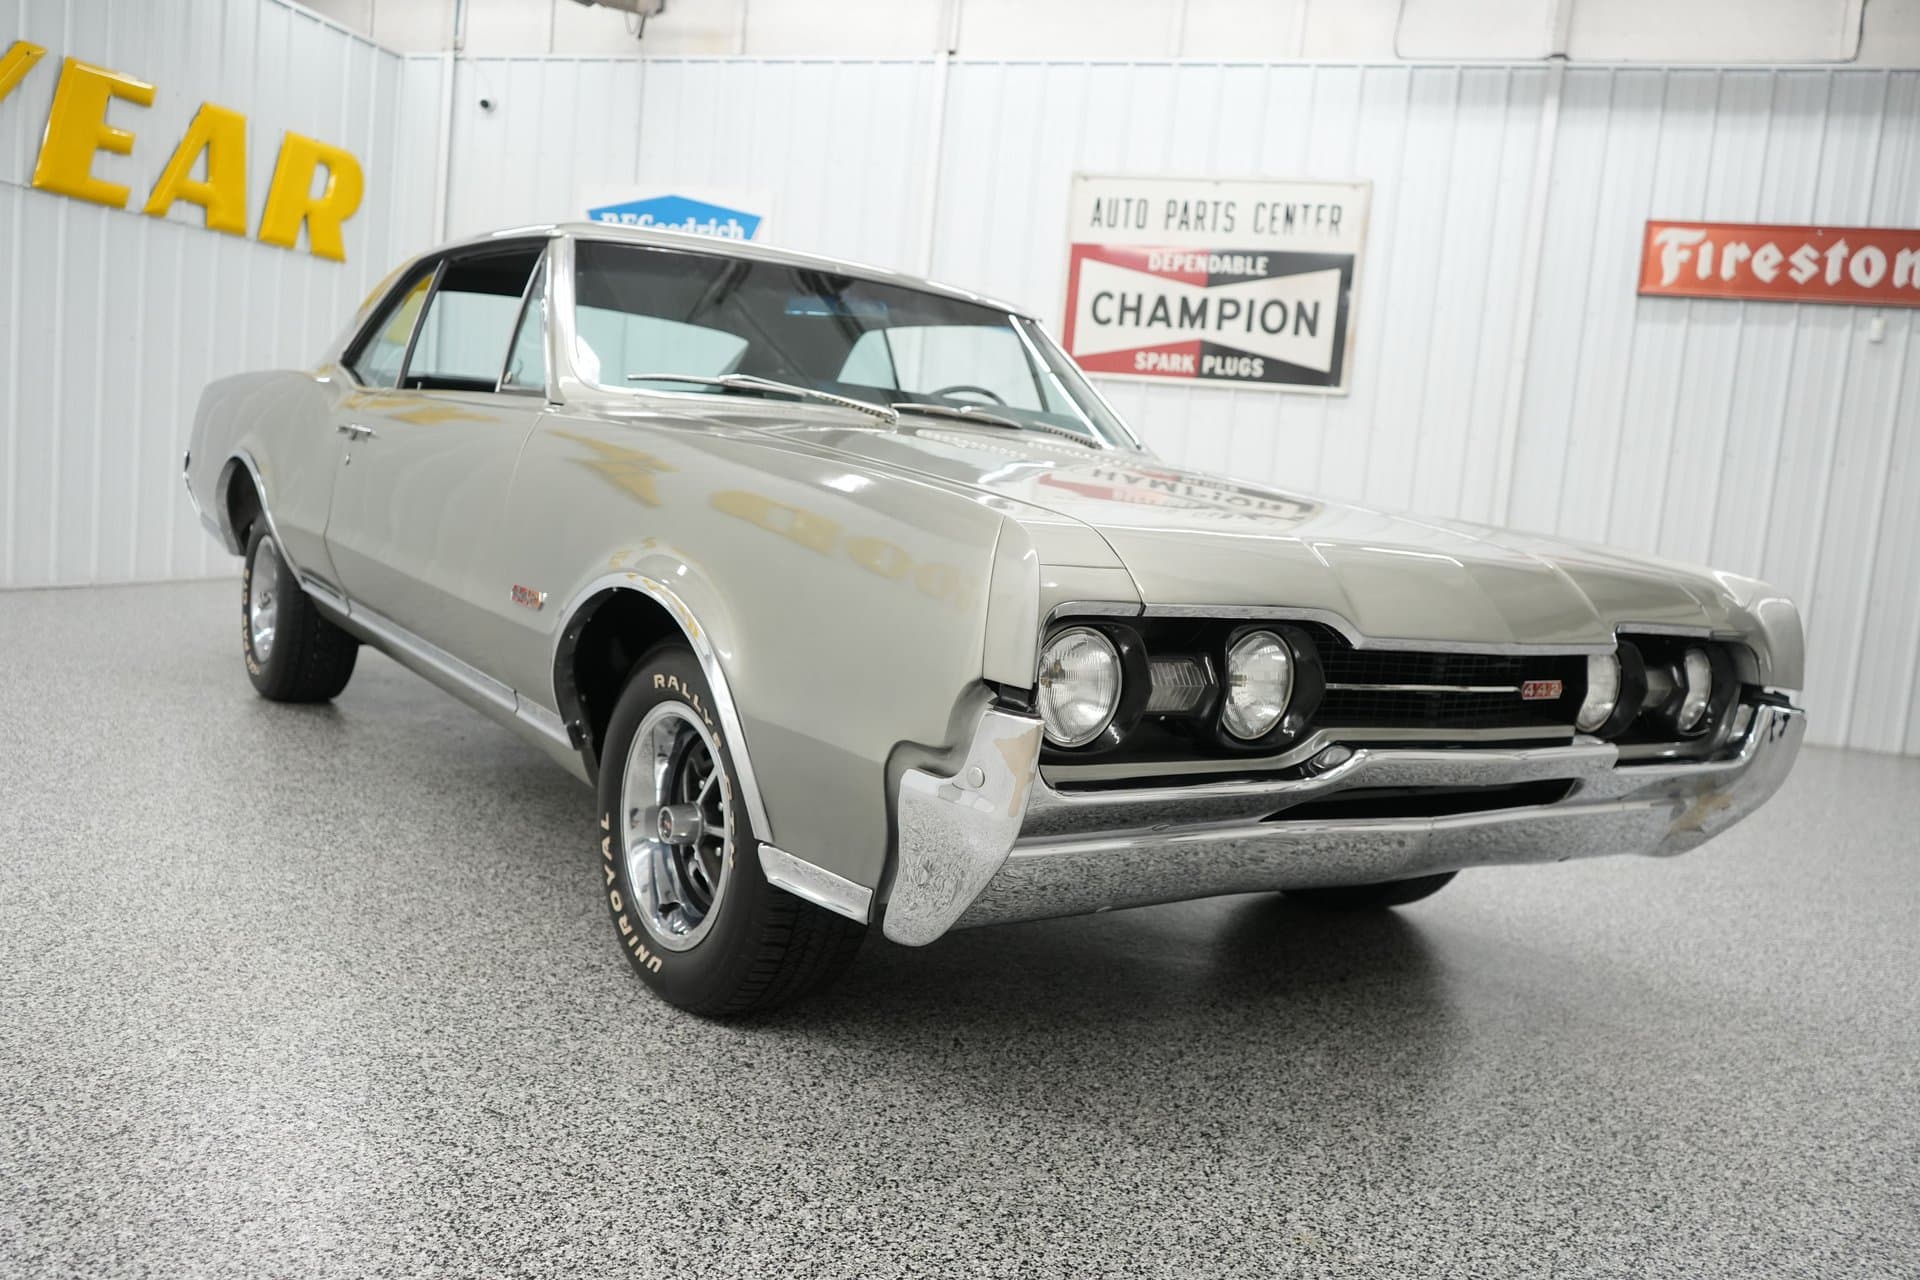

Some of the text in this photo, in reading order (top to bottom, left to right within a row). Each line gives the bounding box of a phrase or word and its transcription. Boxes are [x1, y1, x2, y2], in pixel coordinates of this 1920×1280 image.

[1090, 197, 1149, 229] AUTO
[1163, 199, 1237, 233] PARTS
[1147, 252, 1269, 275] DEPENDABLE
[1091, 291, 1320, 338] CHAMPION
[1135, 350, 1264, 378] SPARK PLUGS
[600, 811, 663, 974] UNIROYAL
